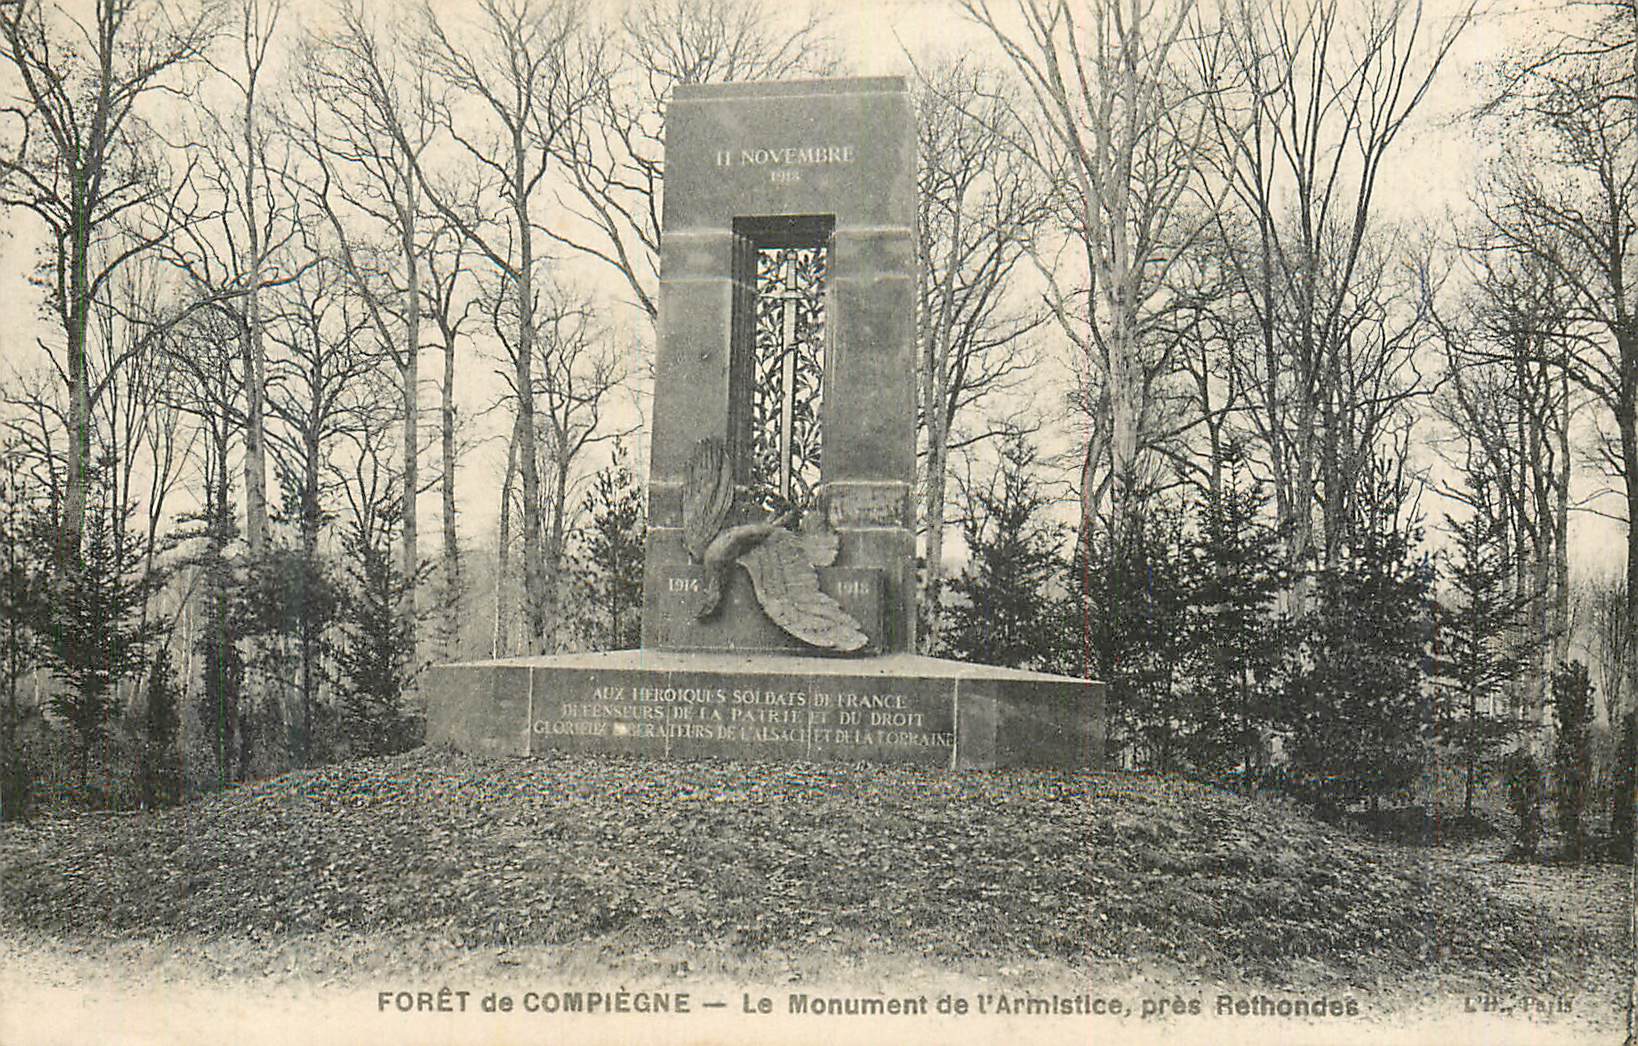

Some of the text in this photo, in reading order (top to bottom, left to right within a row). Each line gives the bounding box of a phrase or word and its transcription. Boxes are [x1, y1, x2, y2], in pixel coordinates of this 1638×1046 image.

[741, 146, 855, 165] NOVEMBRE
[769, 170, 800, 182] 1918
[668, 578, 699, 592] 1914
[837, 581, 869, 595] 1918
[594, 687, 624, 700] AUX
[732, 690, 806, 706] SOLDATS
[838, 694, 907, 709] FRANCE
[674, 706, 695, 720] DE
[699, 707, 721, 720] LA
[840, 711, 861, 725] DU
[871, 712, 924, 727] DROIT
[717, 725, 738, 740] DE
